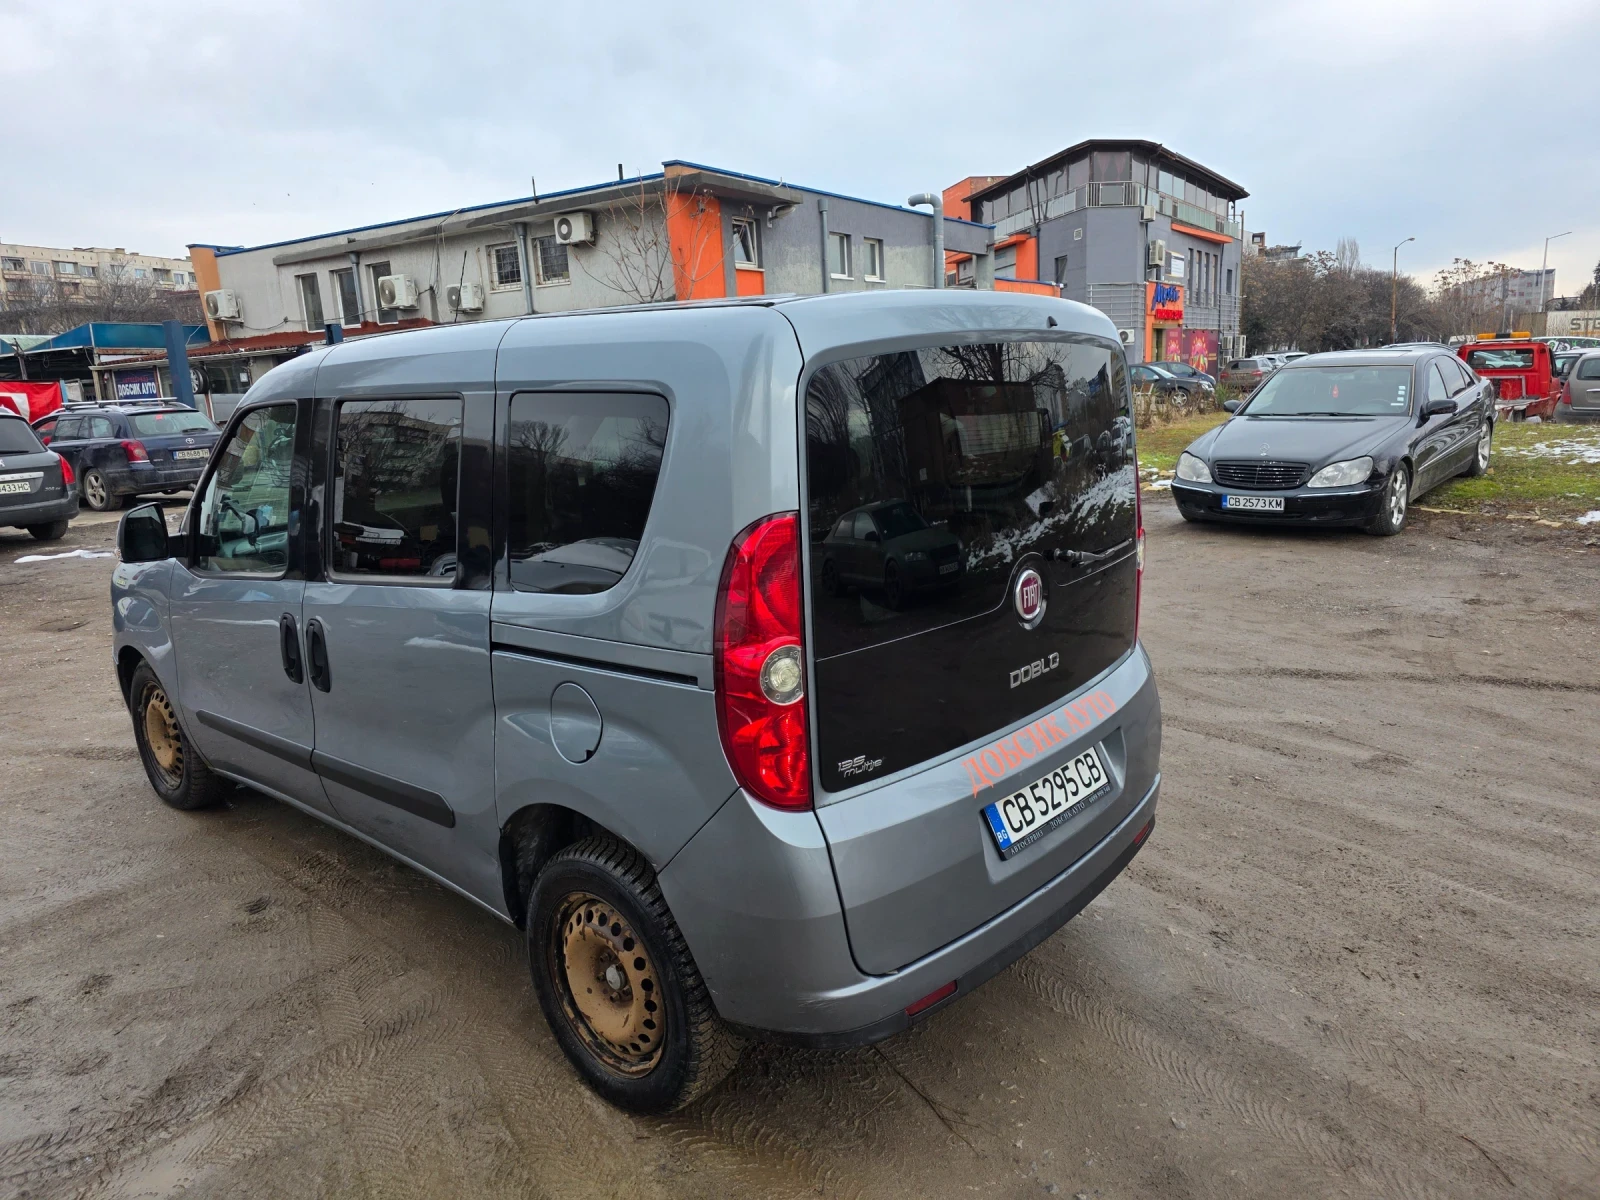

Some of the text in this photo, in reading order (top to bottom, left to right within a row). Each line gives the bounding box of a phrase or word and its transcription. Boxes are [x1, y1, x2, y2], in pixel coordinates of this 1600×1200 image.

[1228, 496, 1241, 507] CB
[1242, 497, 1267, 508] 2573
[1268, 498, 1282, 509] KM
[1023, 583, 1038, 609] FIAT
[962, 690, 1117, 799] ДОБСИК АУТО
[1003, 753, 1101, 833] CB 5295 CB
[996, 829, 1009, 843] BG
[1010, 830, 1044, 855] АВТОСЕРВИЗ
